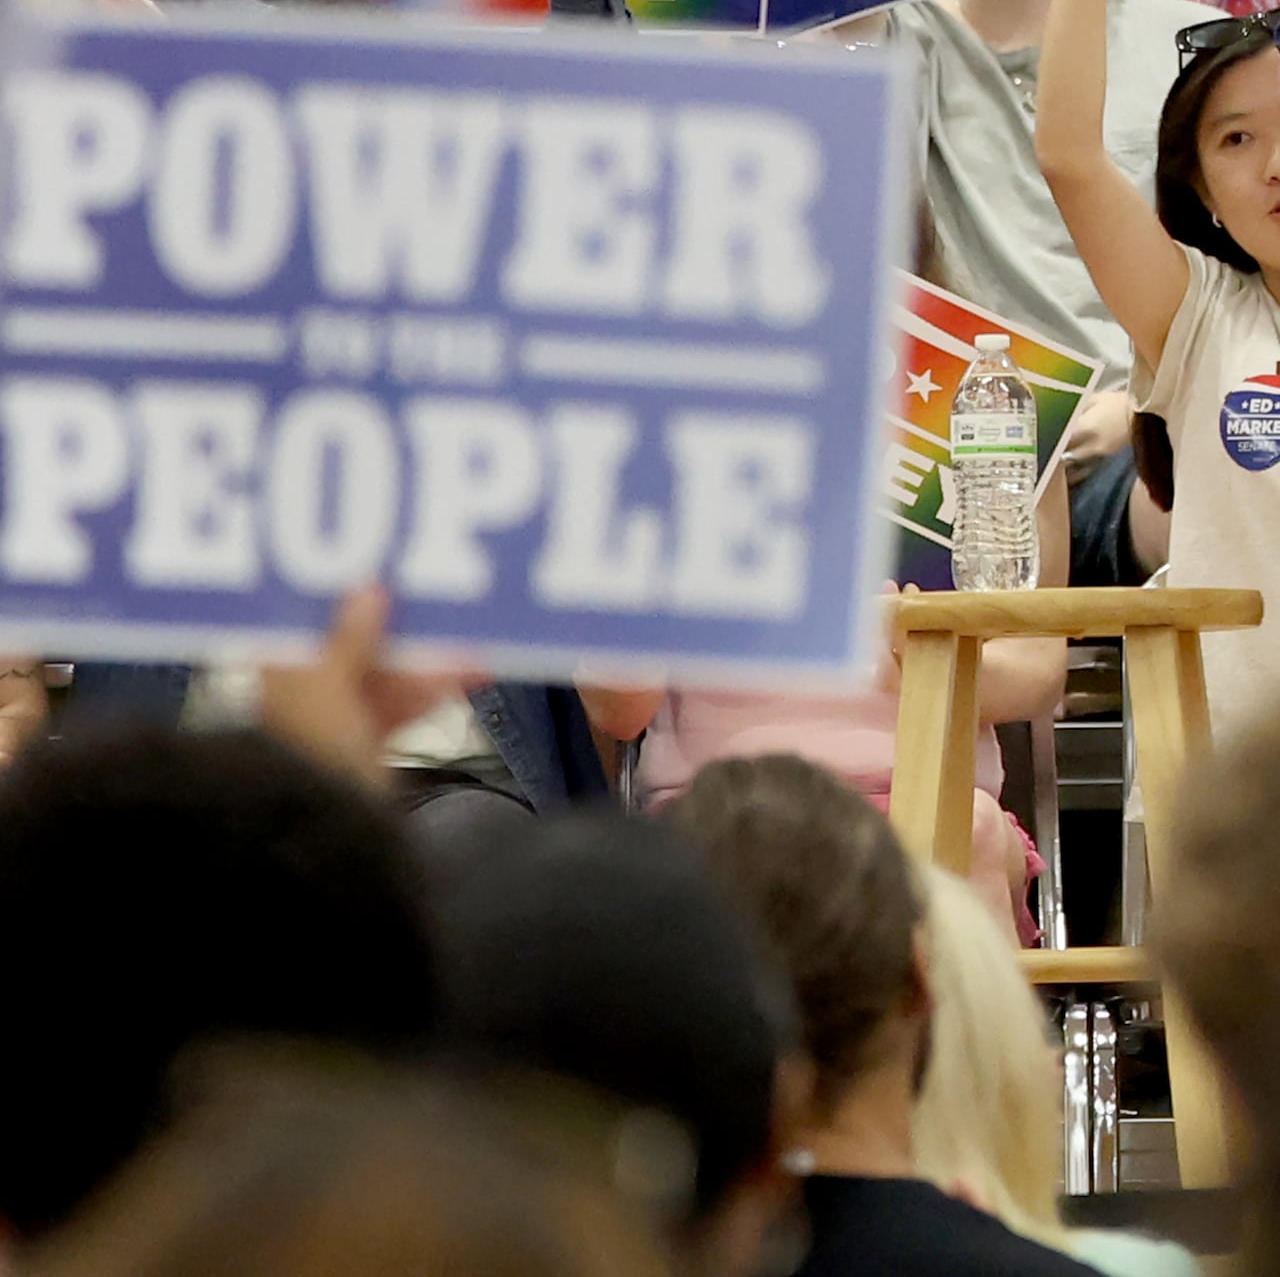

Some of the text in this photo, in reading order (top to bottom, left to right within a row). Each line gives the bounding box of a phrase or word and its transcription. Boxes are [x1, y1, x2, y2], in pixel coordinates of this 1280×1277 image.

[0, 67, 829, 324] POWER
[0, 372, 815, 624] PEOPLE
[1249, 398, 1274, 414] ED
